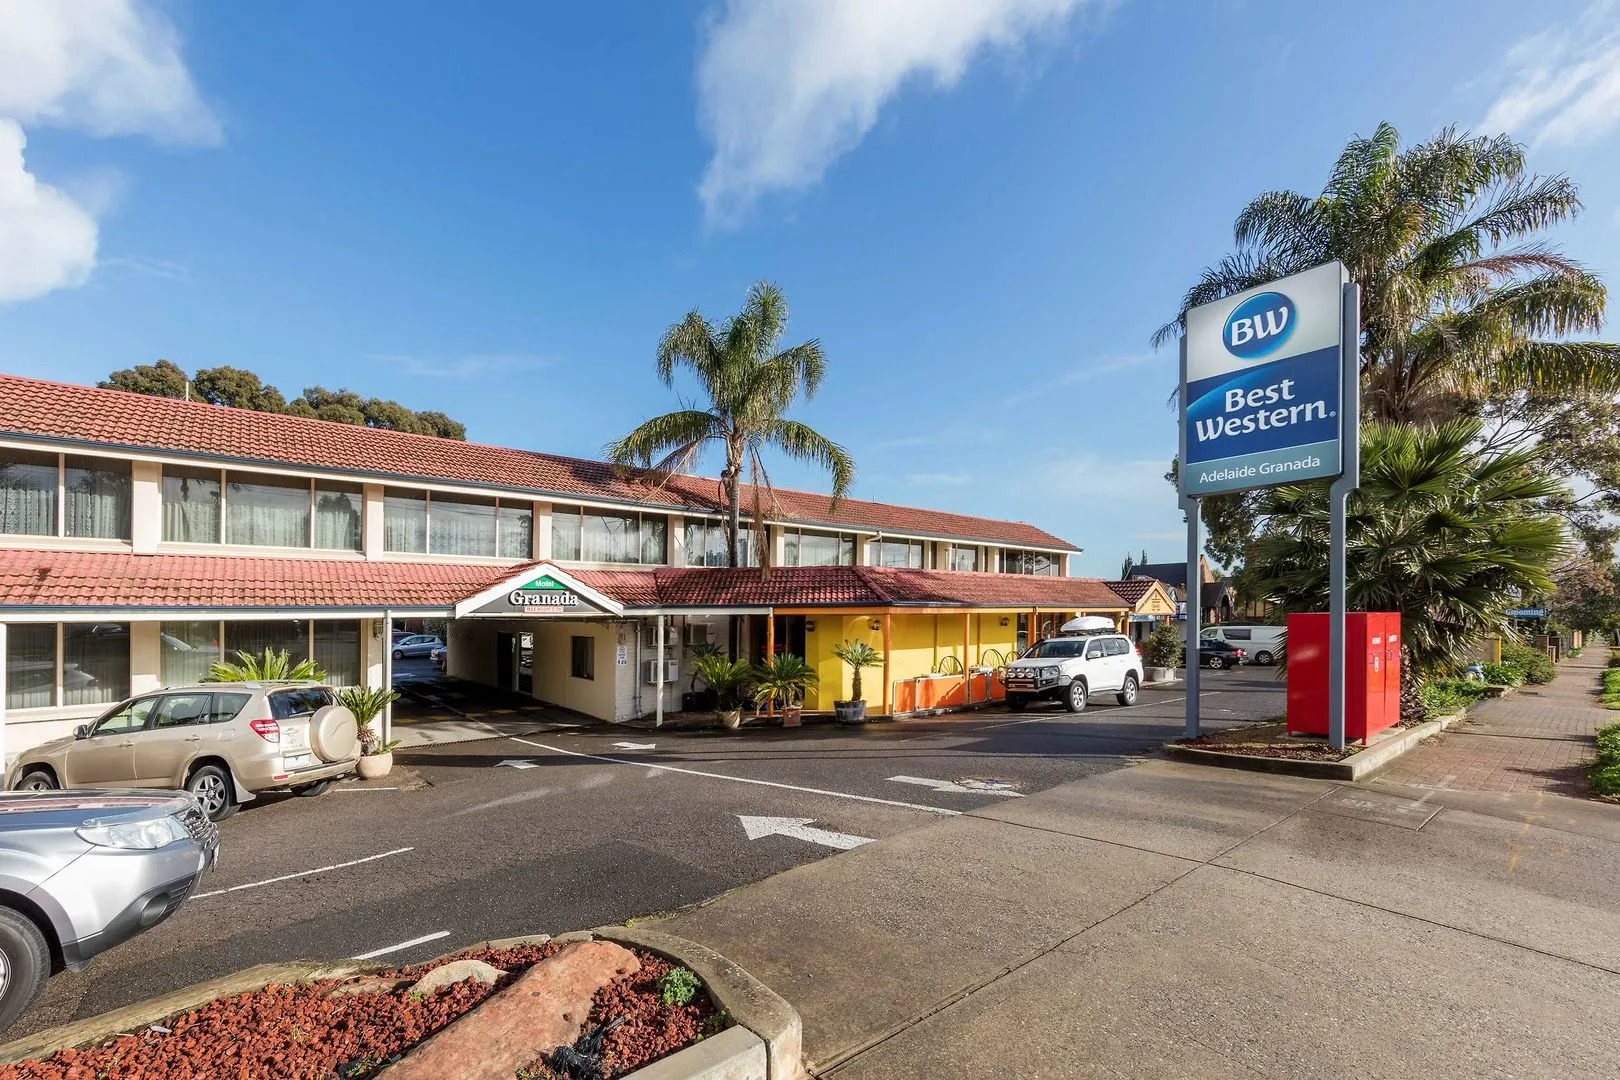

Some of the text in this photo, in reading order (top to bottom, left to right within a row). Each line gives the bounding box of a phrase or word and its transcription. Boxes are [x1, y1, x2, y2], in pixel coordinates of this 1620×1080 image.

[1231, 306, 1288, 346] BW
[1225, 378, 1295, 413] Best
[1199, 455, 1320, 484] Adelaide Granada
[509, 589, 579, 606] Granada
